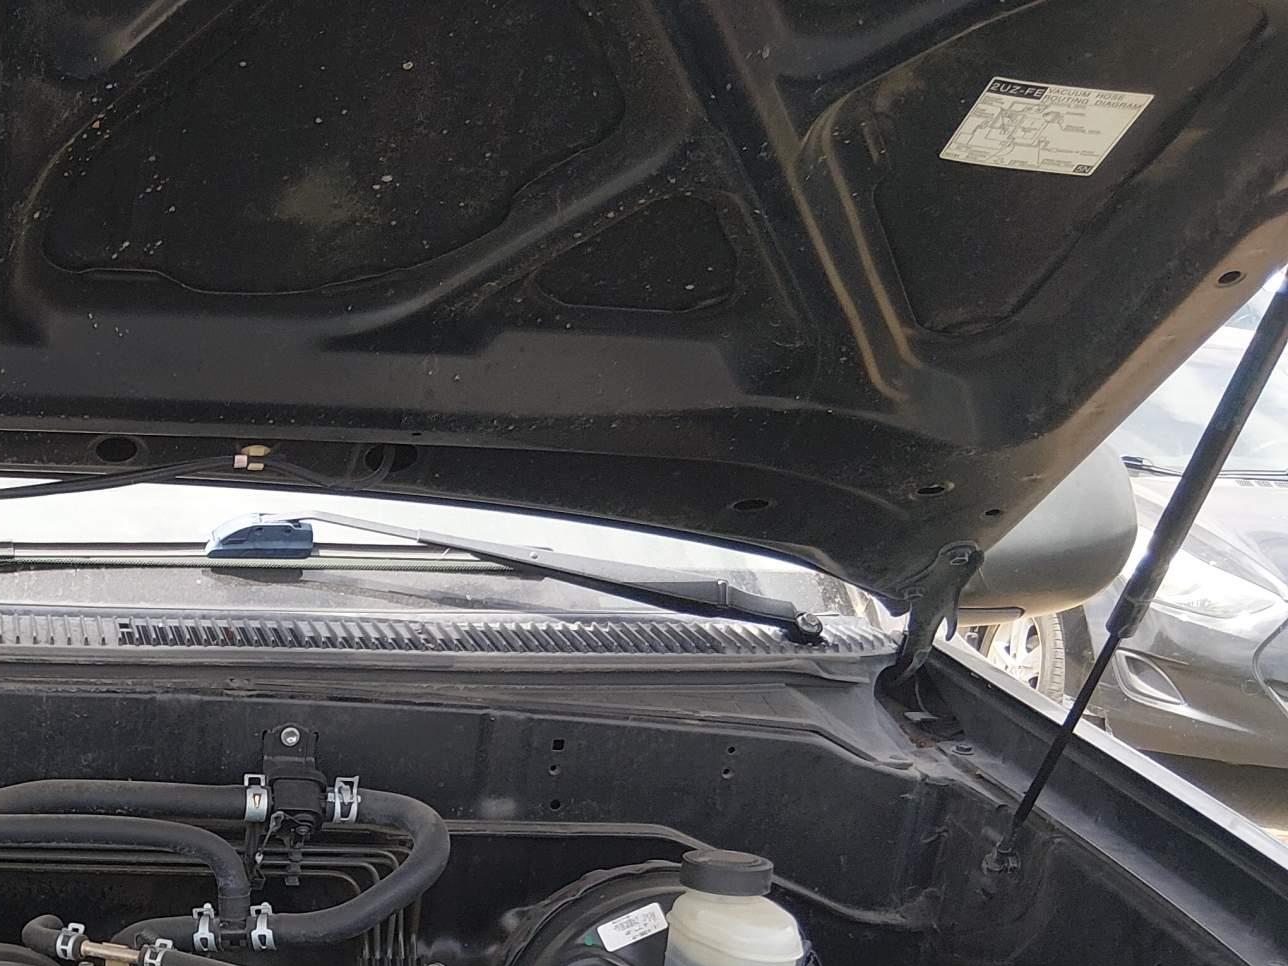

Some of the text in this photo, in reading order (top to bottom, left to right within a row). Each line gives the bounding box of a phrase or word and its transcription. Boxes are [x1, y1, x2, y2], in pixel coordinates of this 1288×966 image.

[990, 82, 1046, 97] 2UZ-FE
[1048, 87, 1126, 101] VACUUM HOSE
[1095, 100, 1145, 110] DIAGRAM
